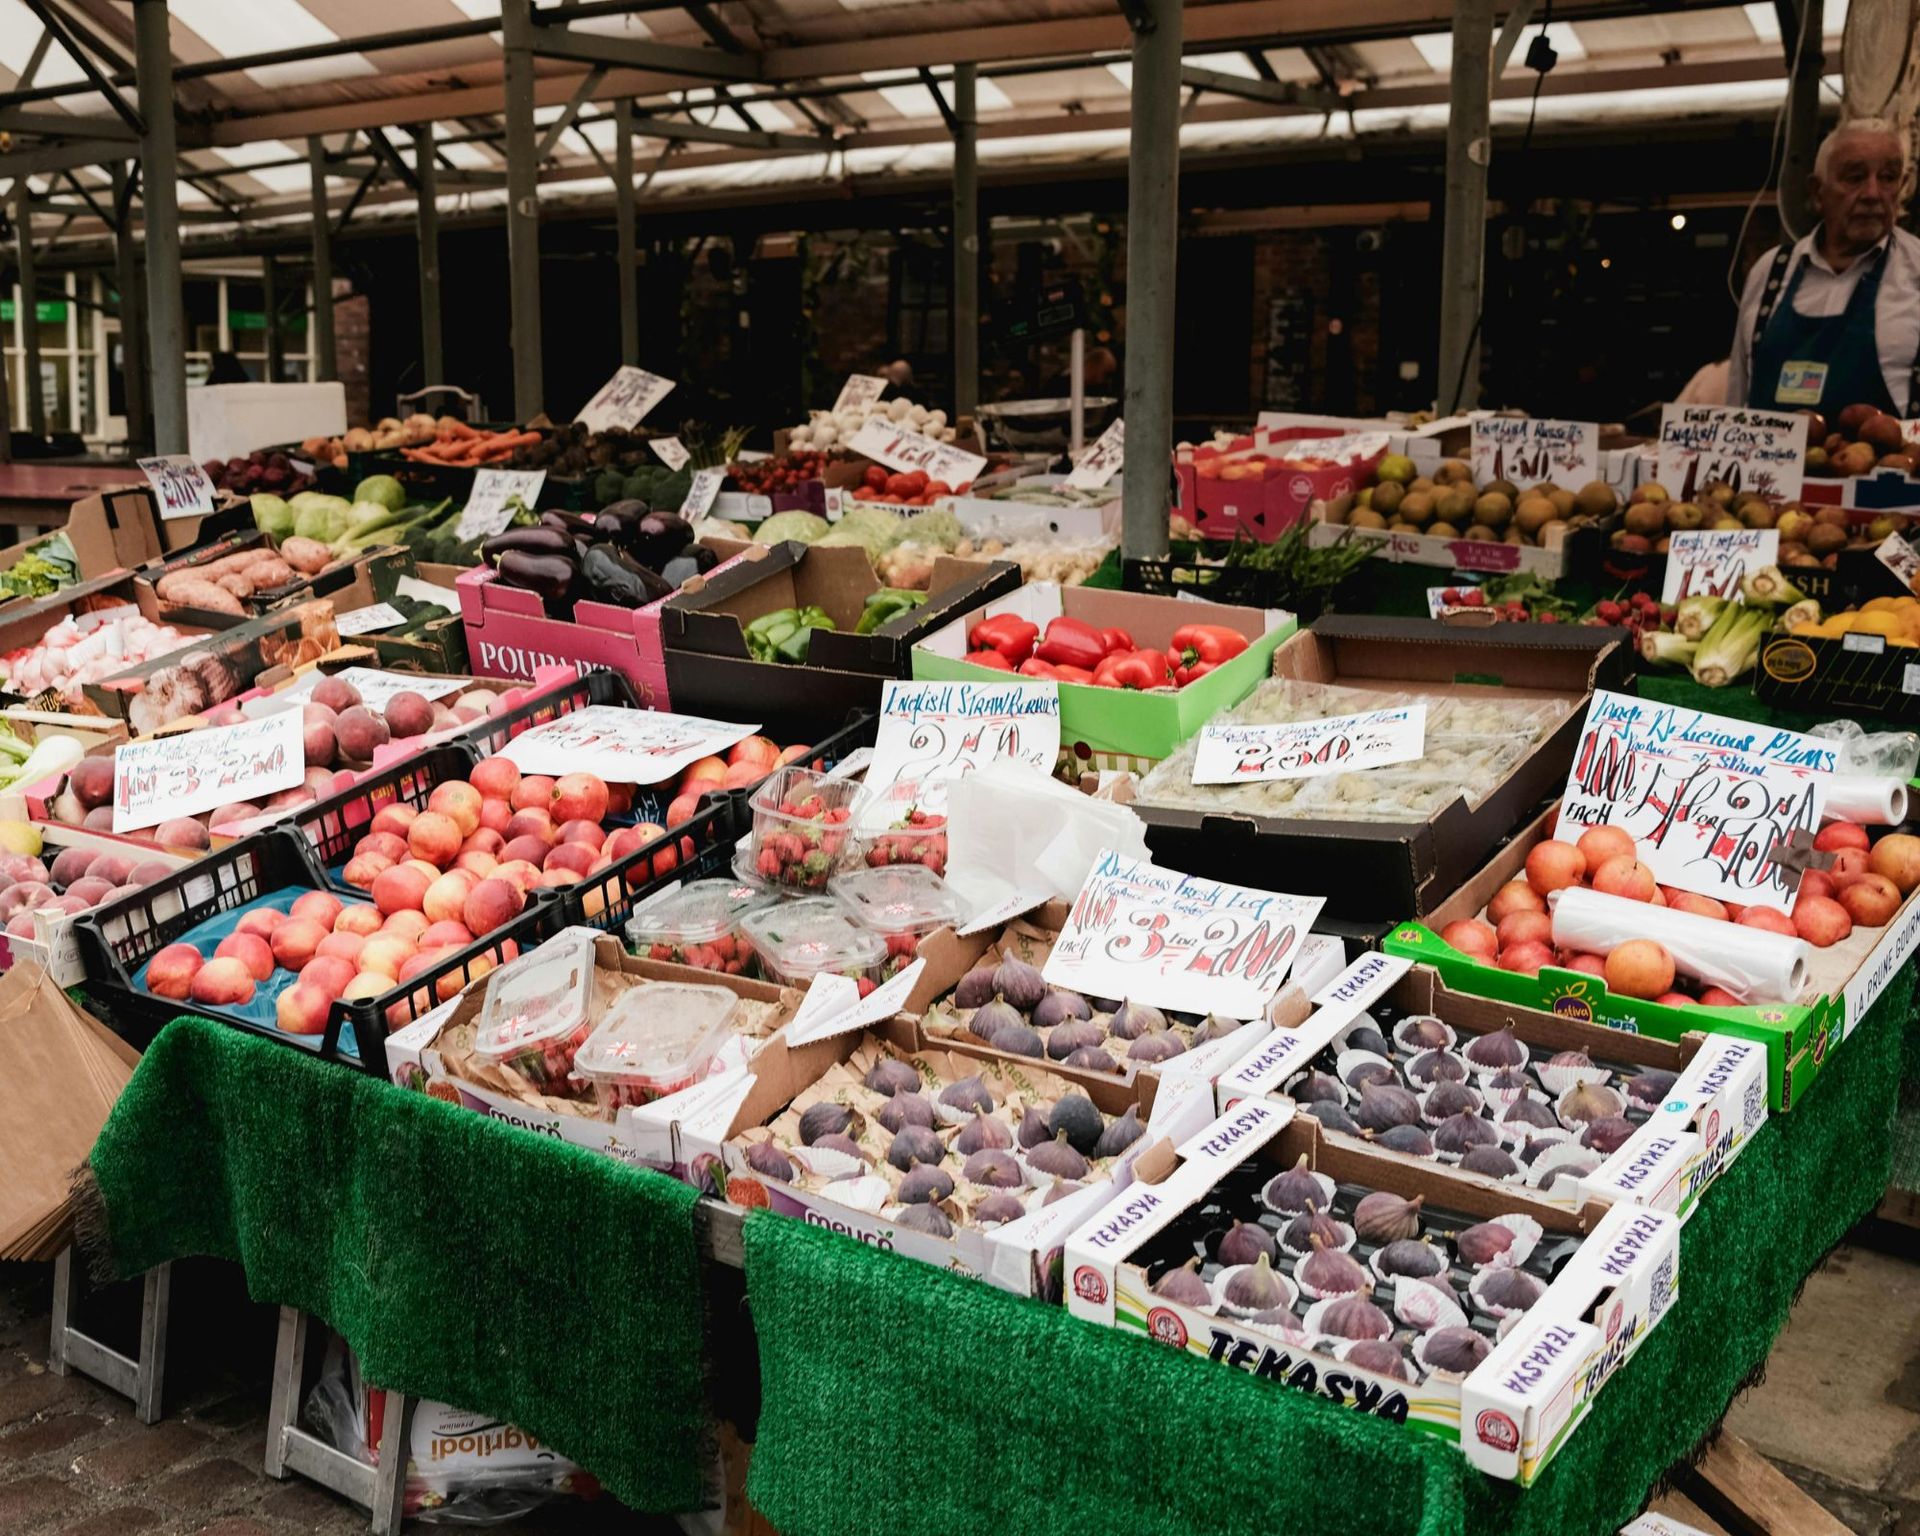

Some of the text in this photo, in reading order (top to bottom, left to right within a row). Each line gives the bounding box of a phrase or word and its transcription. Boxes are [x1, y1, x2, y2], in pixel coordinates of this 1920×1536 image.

[1331, 956, 1390, 1003] TEKASYA
[1868, 947, 1893, 1003] PRUNE
[1236, 1033, 1301, 1084] TEKASYA
[1697, 1043, 1751, 1096] TEKASYA
[605, 1142, 637, 1159] meyco
[1201, 1106, 1272, 1158] TEKASYA
[1613, 1136, 1679, 1190] TEKASYA
[1688, 1126, 1735, 1199] TEKASYA
[1088, 1192, 1163, 1249] TEKASYA
[1599, 1212, 1664, 1277] TEKASYA
[1207, 1326, 1411, 1425] TEKASYA
[1500, 1324, 1579, 1395] TEKASYA
[1583, 1314, 1639, 1401] TEKASYA
